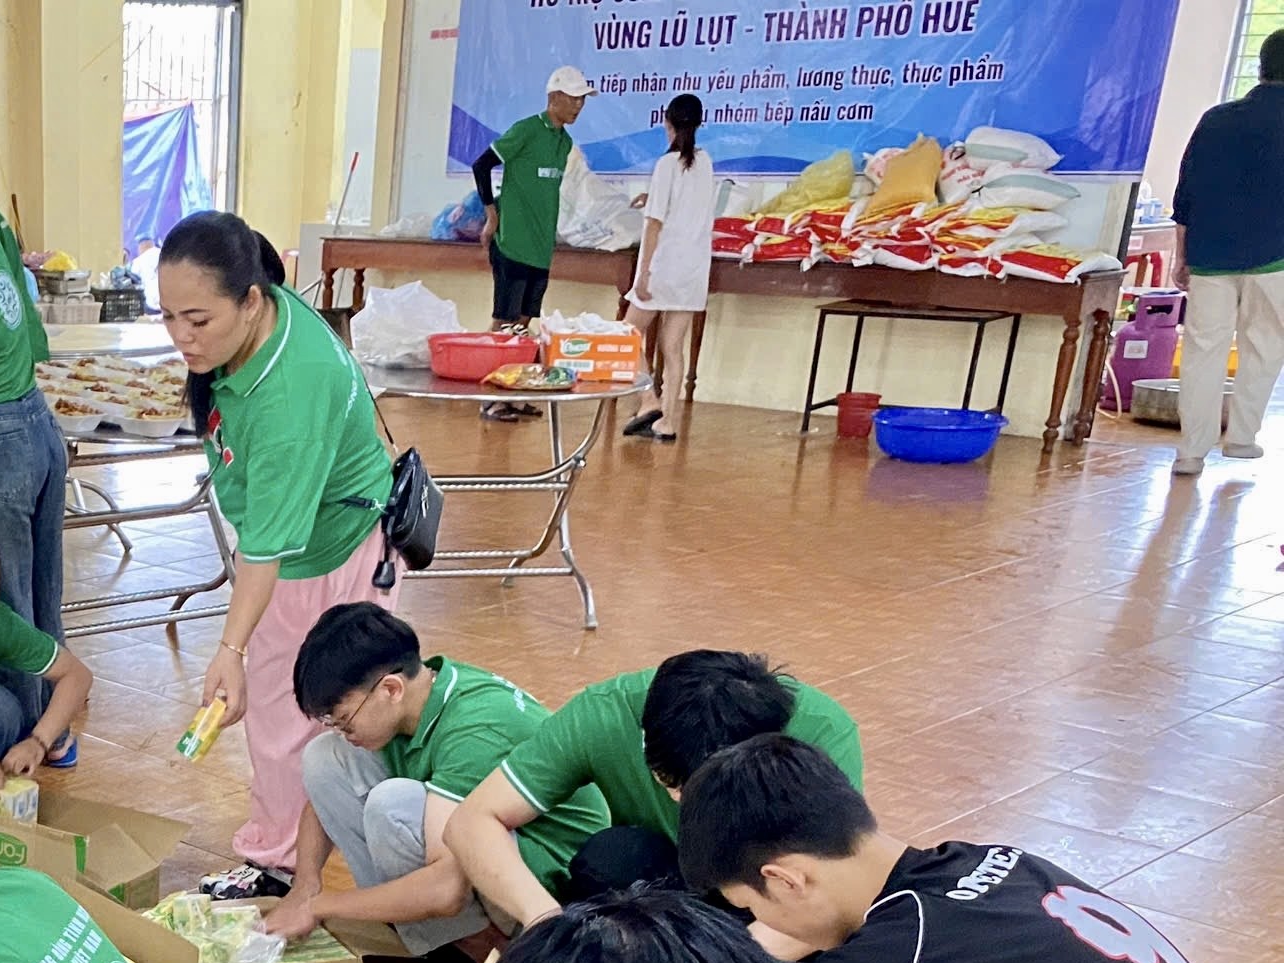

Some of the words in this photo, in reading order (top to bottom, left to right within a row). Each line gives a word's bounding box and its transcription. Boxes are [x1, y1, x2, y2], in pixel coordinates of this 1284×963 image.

[594, 14, 651, 50] VÙNG
[659, 10, 688, 47] LŨ
[694, 14, 738, 51] LỤT
[764, 1, 848, 42] THÀNH
[600, 73, 627, 96] tiếp
[632, 72, 667, 96] nhận
[672, 72, 702, 91] nhu
[708, 67, 735, 93] yếu
[796, 66, 844, 91] lương
[902, 63, 942, 88] thực
[949, 54, 1004, 86] phẩm
[714, 104, 758, 123] nhóm
[764, 101, 794, 126] bếp
[800, 98, 831, 122] nấu
[837, 103, 874, 121] cơm
